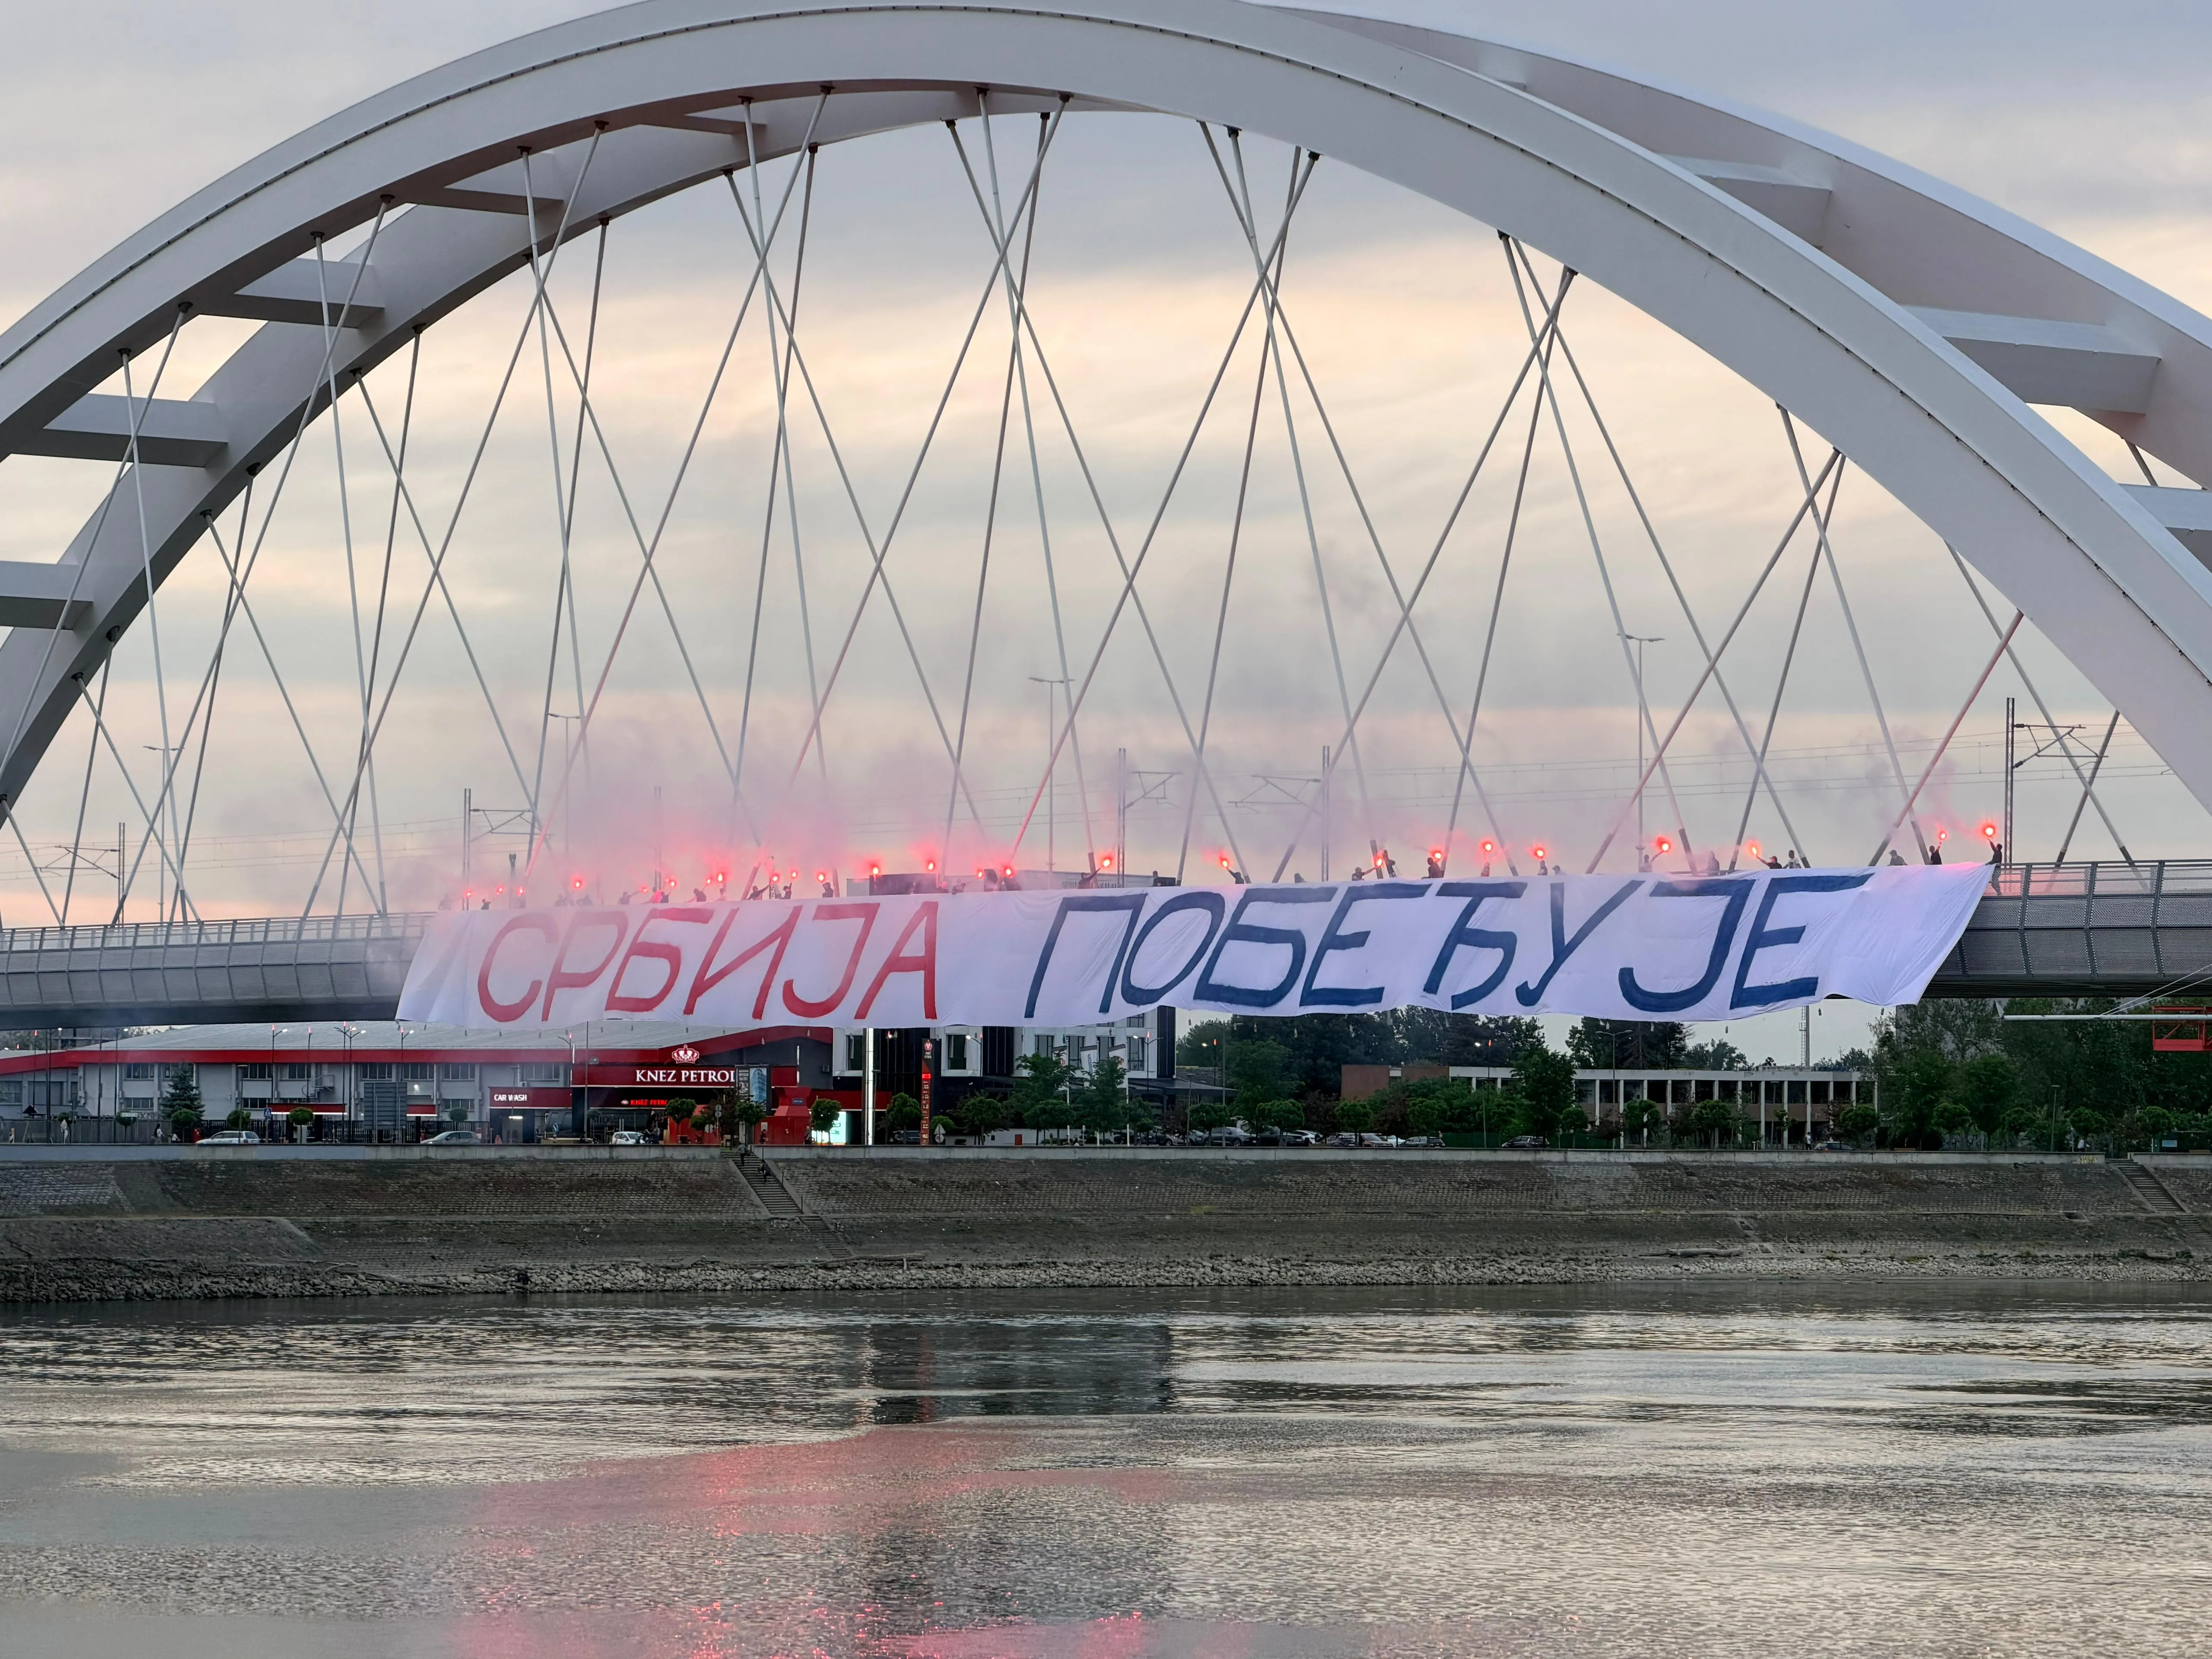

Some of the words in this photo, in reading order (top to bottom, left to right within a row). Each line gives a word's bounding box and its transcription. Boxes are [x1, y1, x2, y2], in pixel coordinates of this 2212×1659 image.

[478, 901, 939, 1022] СРБИЈА
[1024, 873, 1875, 1018] ПОБЕЂУЈЕ
[636, 1070, 677, 1082] KNEZ
